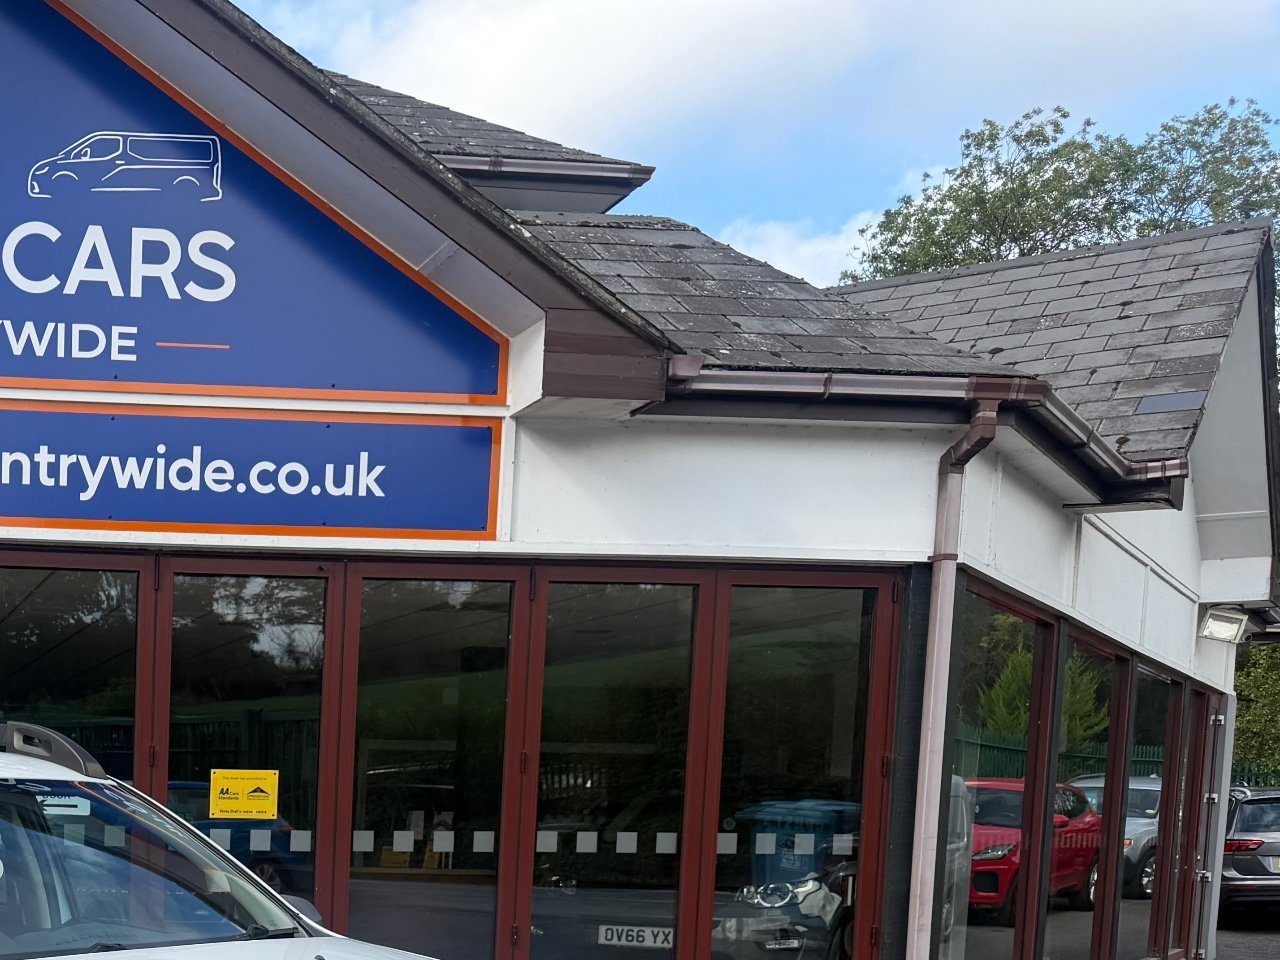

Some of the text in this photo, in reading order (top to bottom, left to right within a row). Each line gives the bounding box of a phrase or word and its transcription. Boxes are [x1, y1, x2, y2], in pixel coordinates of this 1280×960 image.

[2, 222, 236, 302] CARS
[604, 927, 671, 945] OV66 YX
